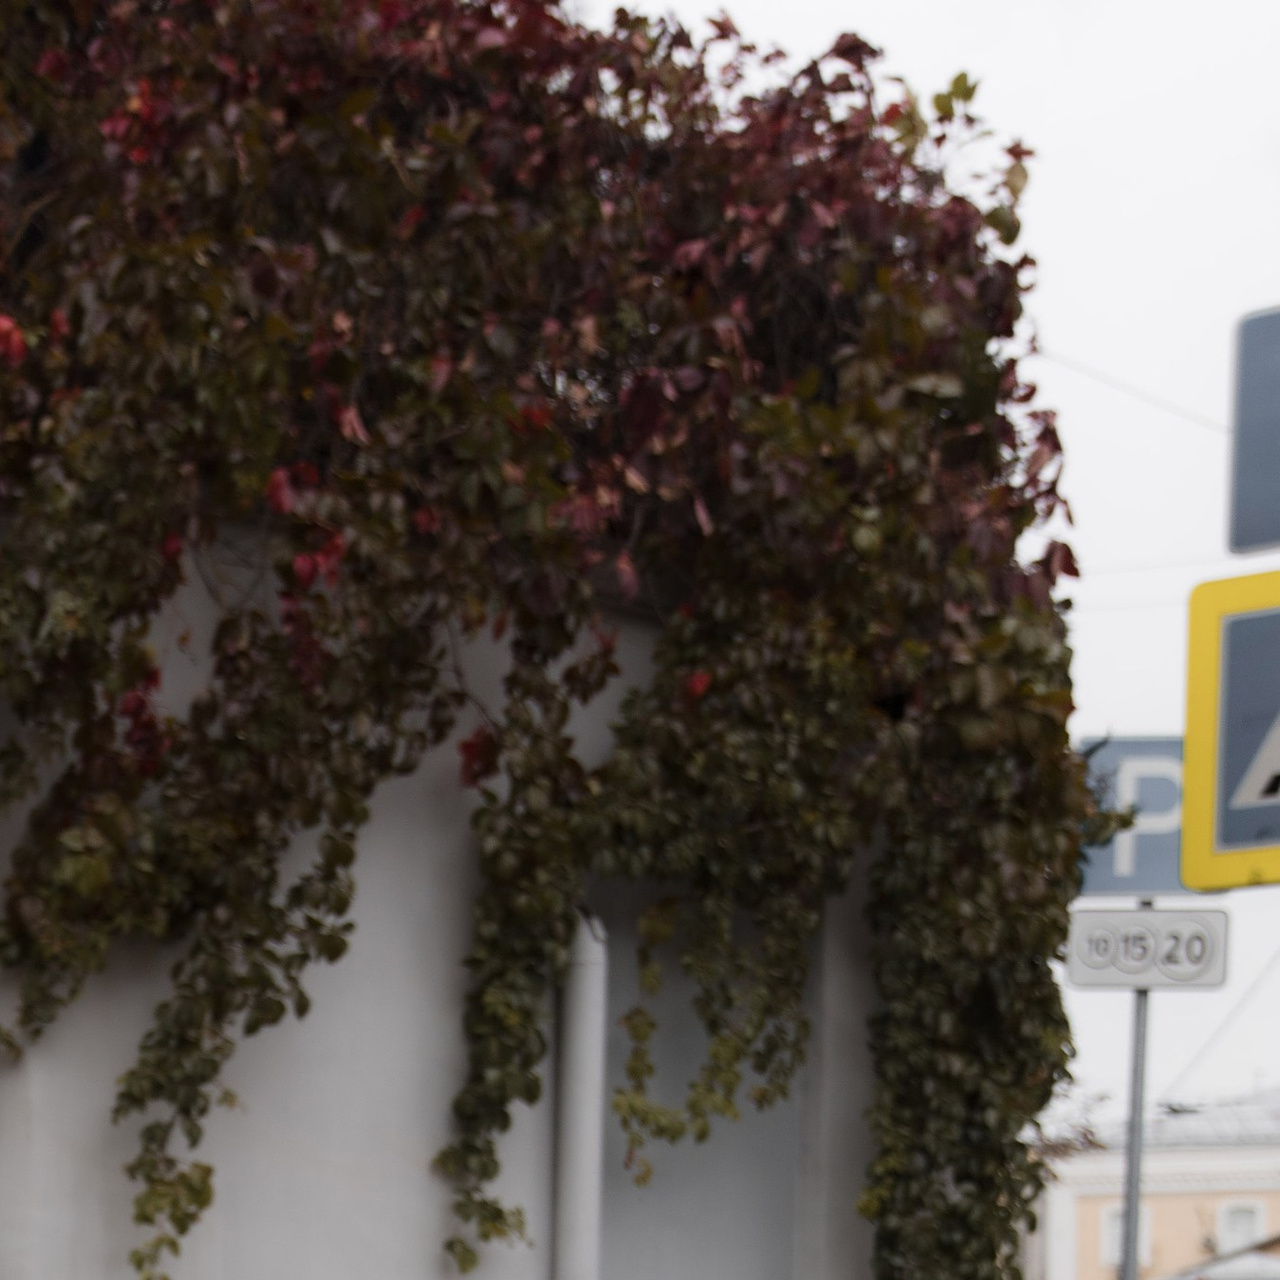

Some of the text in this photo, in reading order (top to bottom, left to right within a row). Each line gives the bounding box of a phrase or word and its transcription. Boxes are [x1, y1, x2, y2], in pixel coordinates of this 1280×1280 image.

[1114, 758, 1183, 876] P
[1087, 933, 1206, 965] 10 15 20
